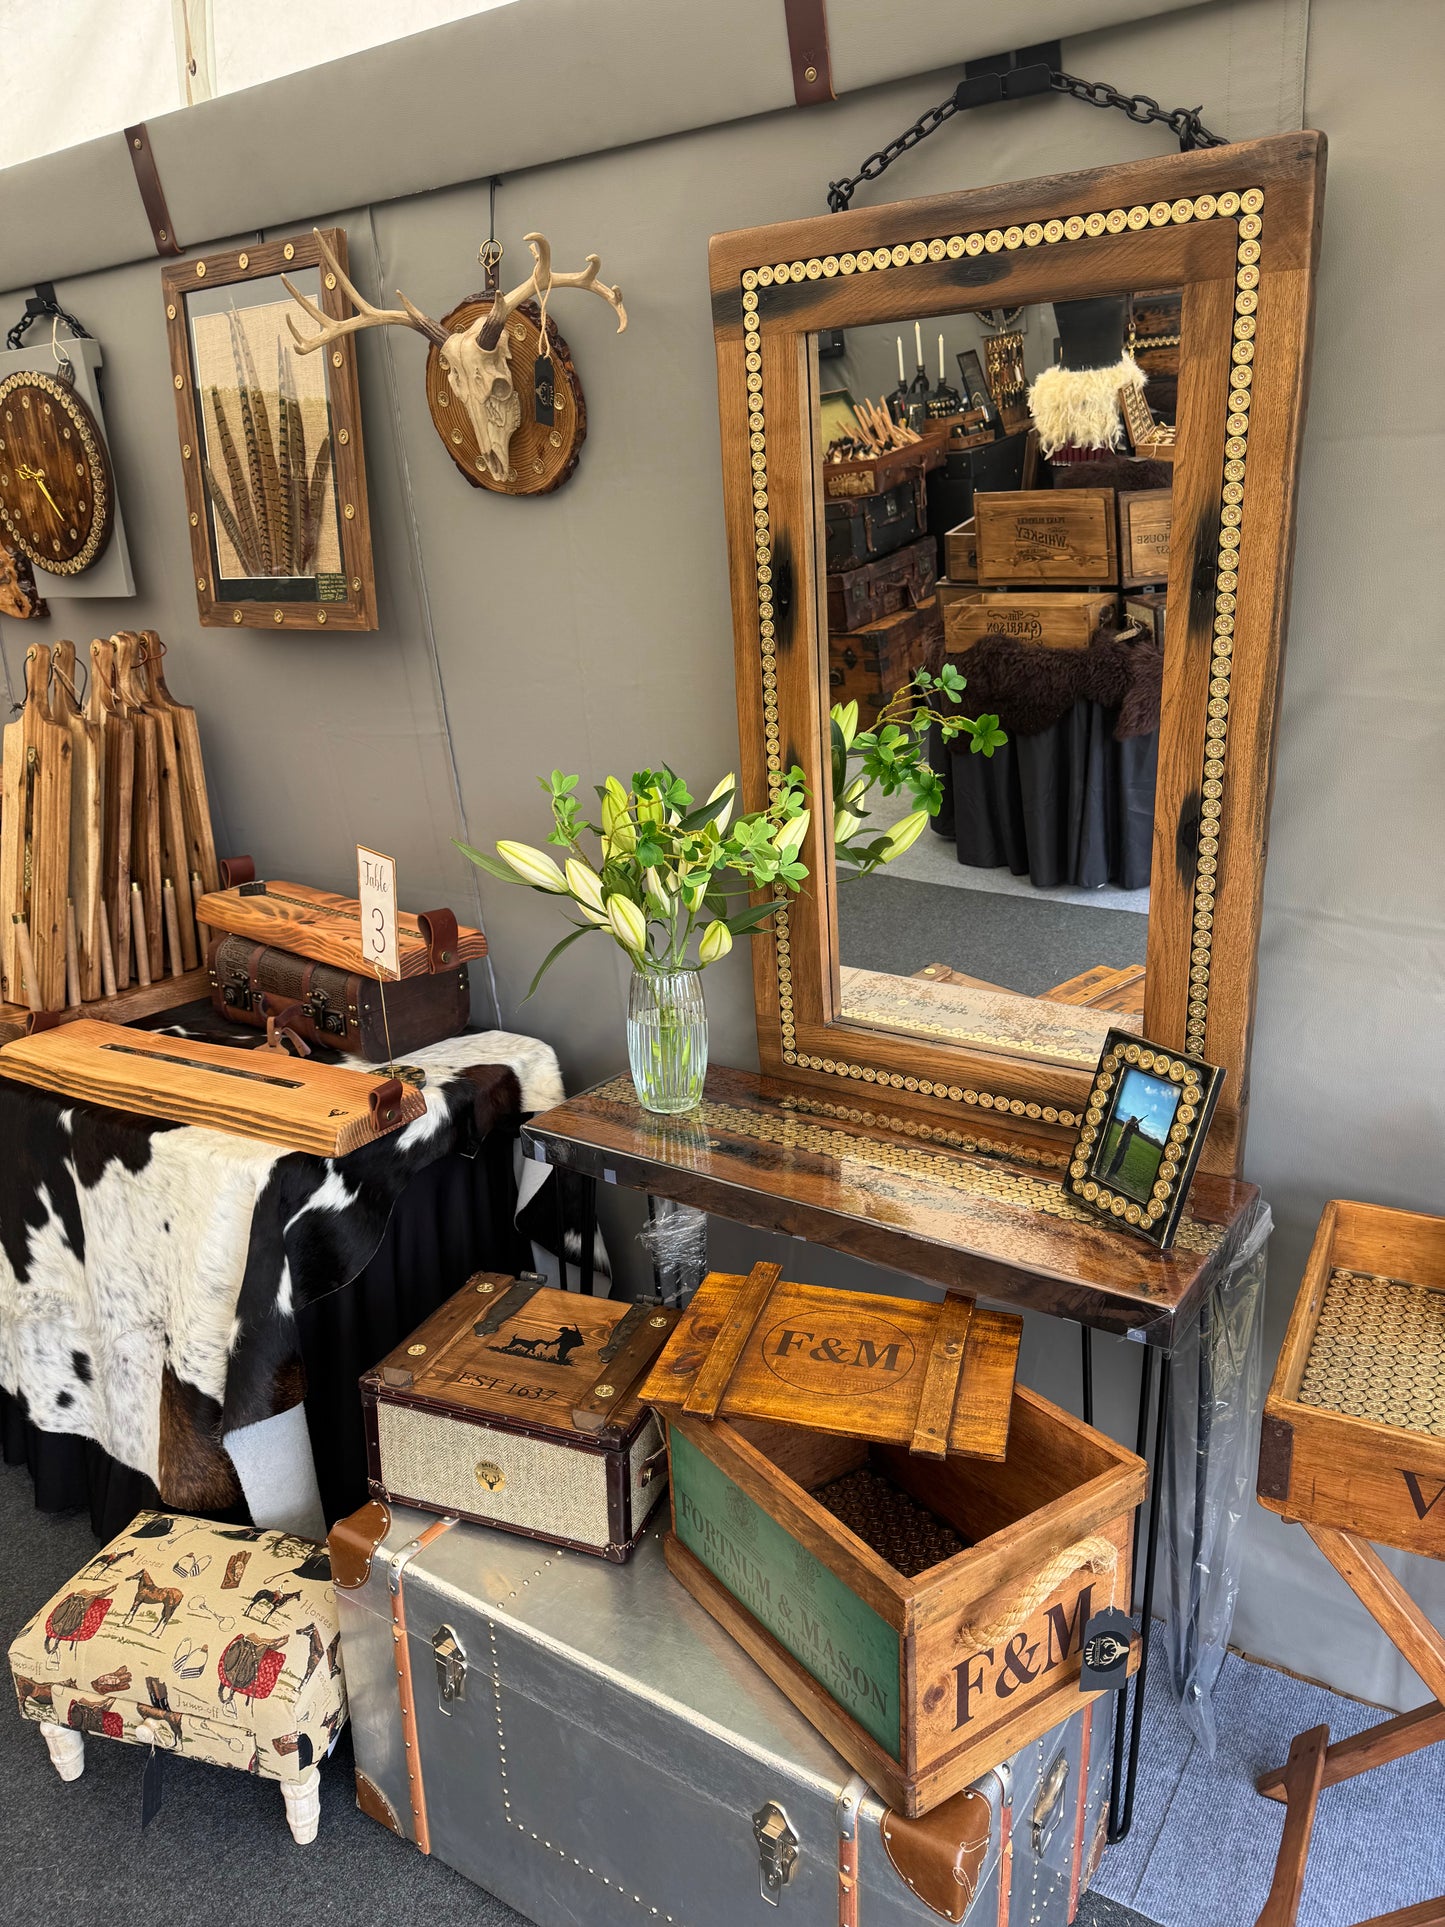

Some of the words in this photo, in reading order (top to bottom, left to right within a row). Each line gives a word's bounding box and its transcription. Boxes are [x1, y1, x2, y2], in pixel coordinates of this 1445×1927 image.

[363, 860, 388, 893] Table
[371, 907, 386, 954] 3
[770, 1329, 905, 1372] F&M
[456, 1371, 504, 1391] EST
[505, 1382, 558, 1402] 1637
[299, 1599, 333, 1630] Horses
[680, 1490, 771, 1601] FORTNUM
[778, 1593, 793, 1621] &
[800, 1607, 888, 1717] MASON
[703, 1541, 774, 1624] PICCADILLY
[777, 1617, 818, 1667] SINCE
[821, 1662, 859, 1709] 1707
[951, 1581, 1097, 1732] F&M
[1085, 1640, 1097, 1666] MILI
